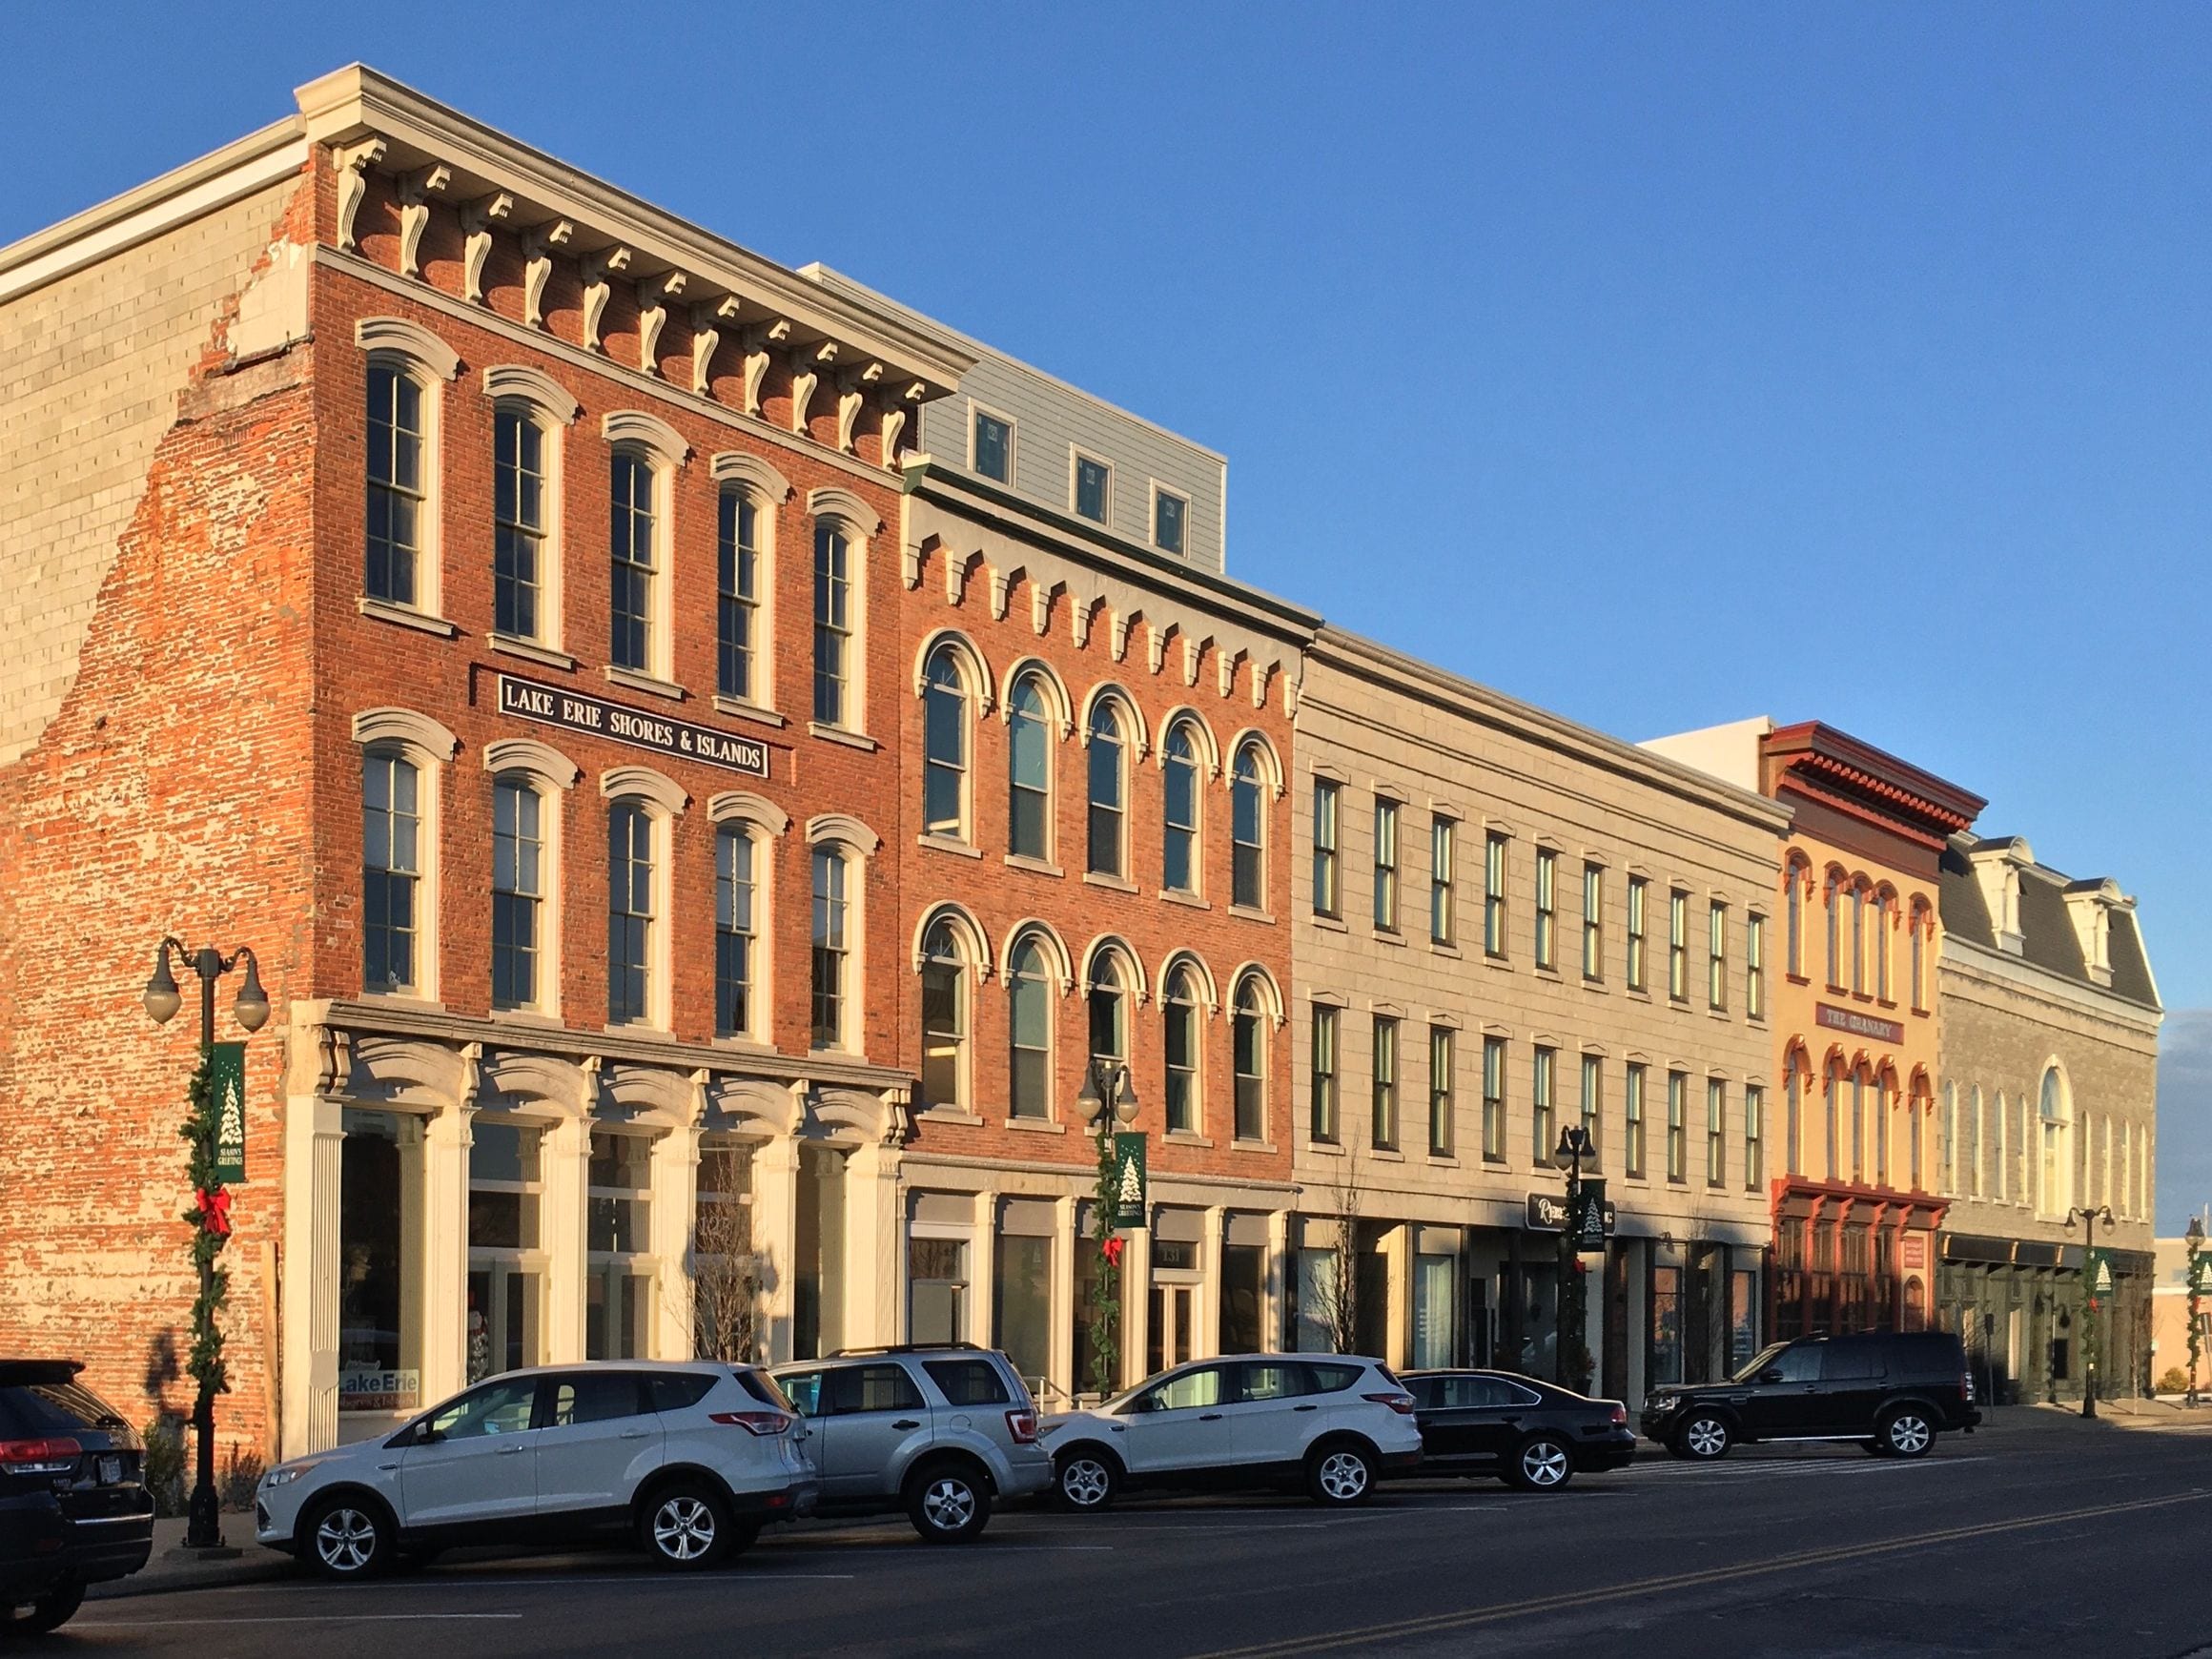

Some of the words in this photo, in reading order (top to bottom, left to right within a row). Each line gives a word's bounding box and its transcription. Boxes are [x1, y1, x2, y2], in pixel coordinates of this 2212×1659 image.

[506, 685, 554, 716] LAKE
[563, 699, 602, 728] ERIE
[610, 712, 673, 747] SHORES
[680, 730, 692, 751] &
[696, 733, 760, 768] ISLANDS
[1827, 1009, 1846, 1027] THE
[1849, 1014, 1892, 1037] GRANARY
[1162, 1248, 1179, 1262] 131
[340, 1374, 380, 1392] ake
[382, 1374, 417, 1392] Erie
